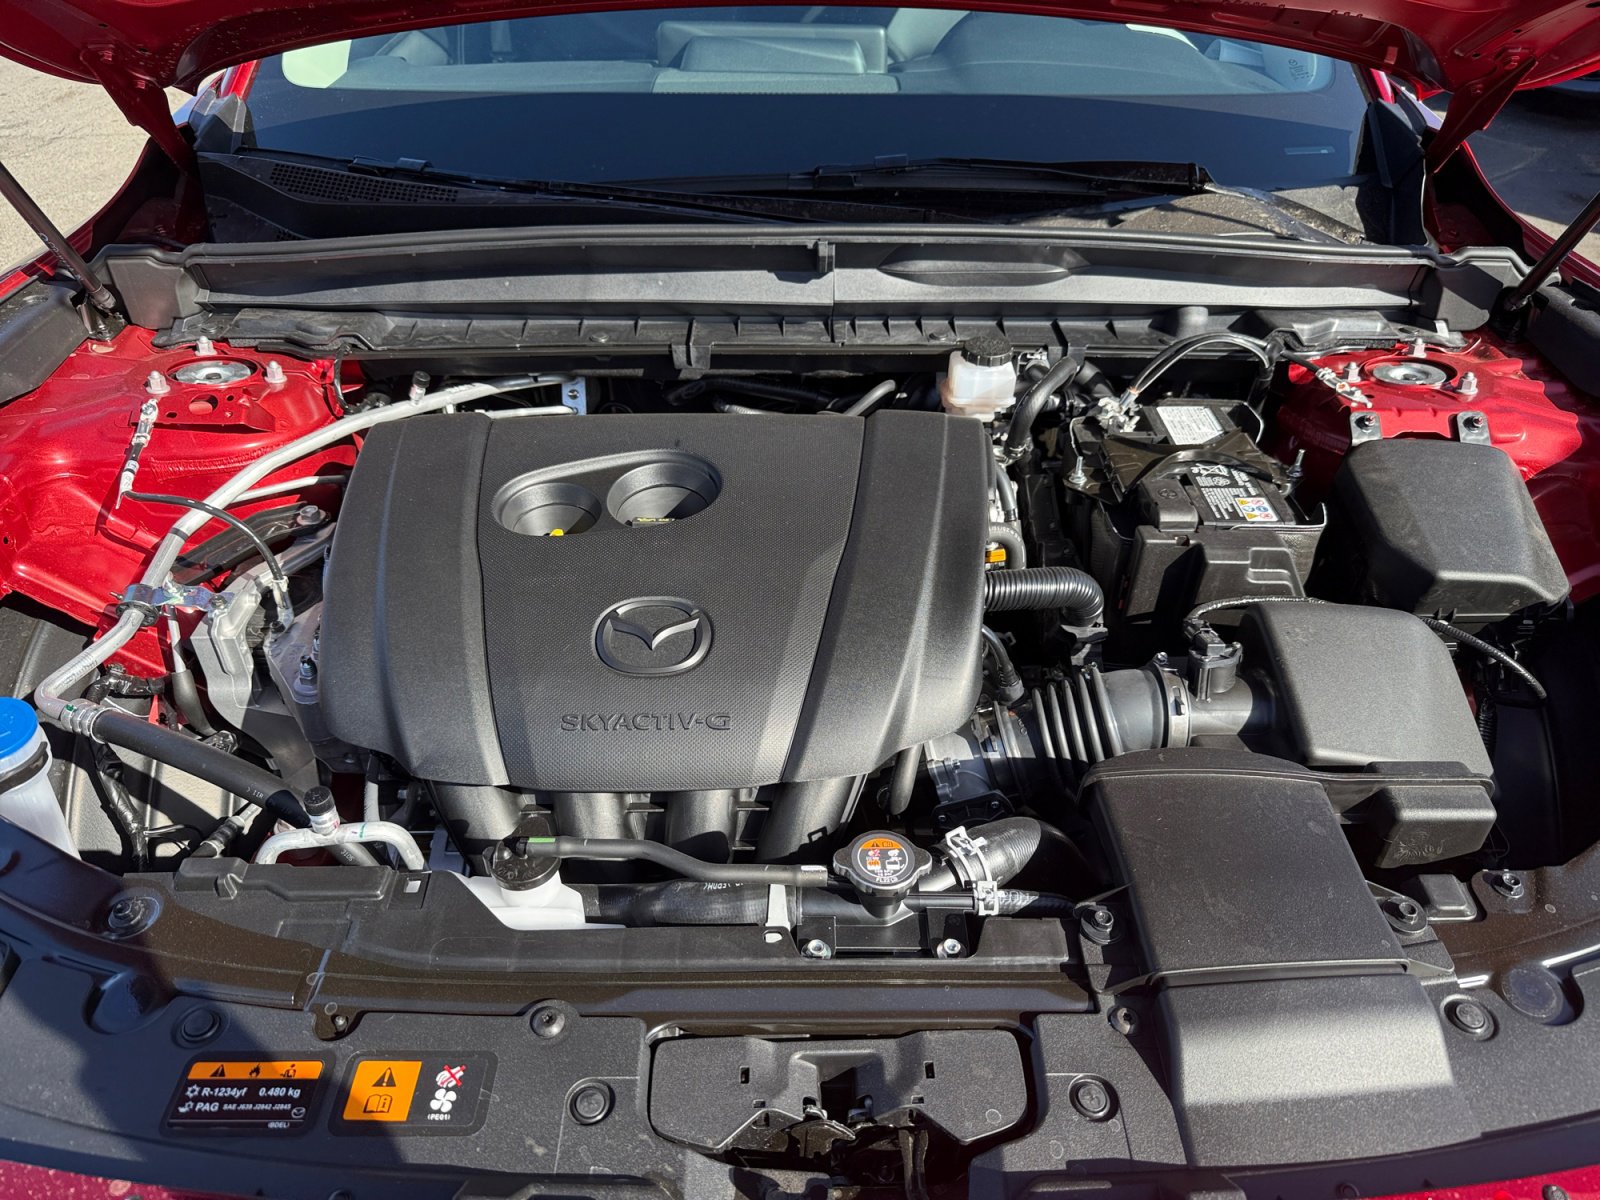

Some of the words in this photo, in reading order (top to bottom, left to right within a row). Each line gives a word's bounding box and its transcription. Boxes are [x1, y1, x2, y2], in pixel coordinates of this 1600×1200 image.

[560, 712, 731, 732] SKYACTIV-G
[201, 1086, 248, 1099] R-1234yf
[258, 1087, 286, 1097] 0.480
[287, 1086, 301, 1099] kg
[195, 1102, 220, 1113] PAG
